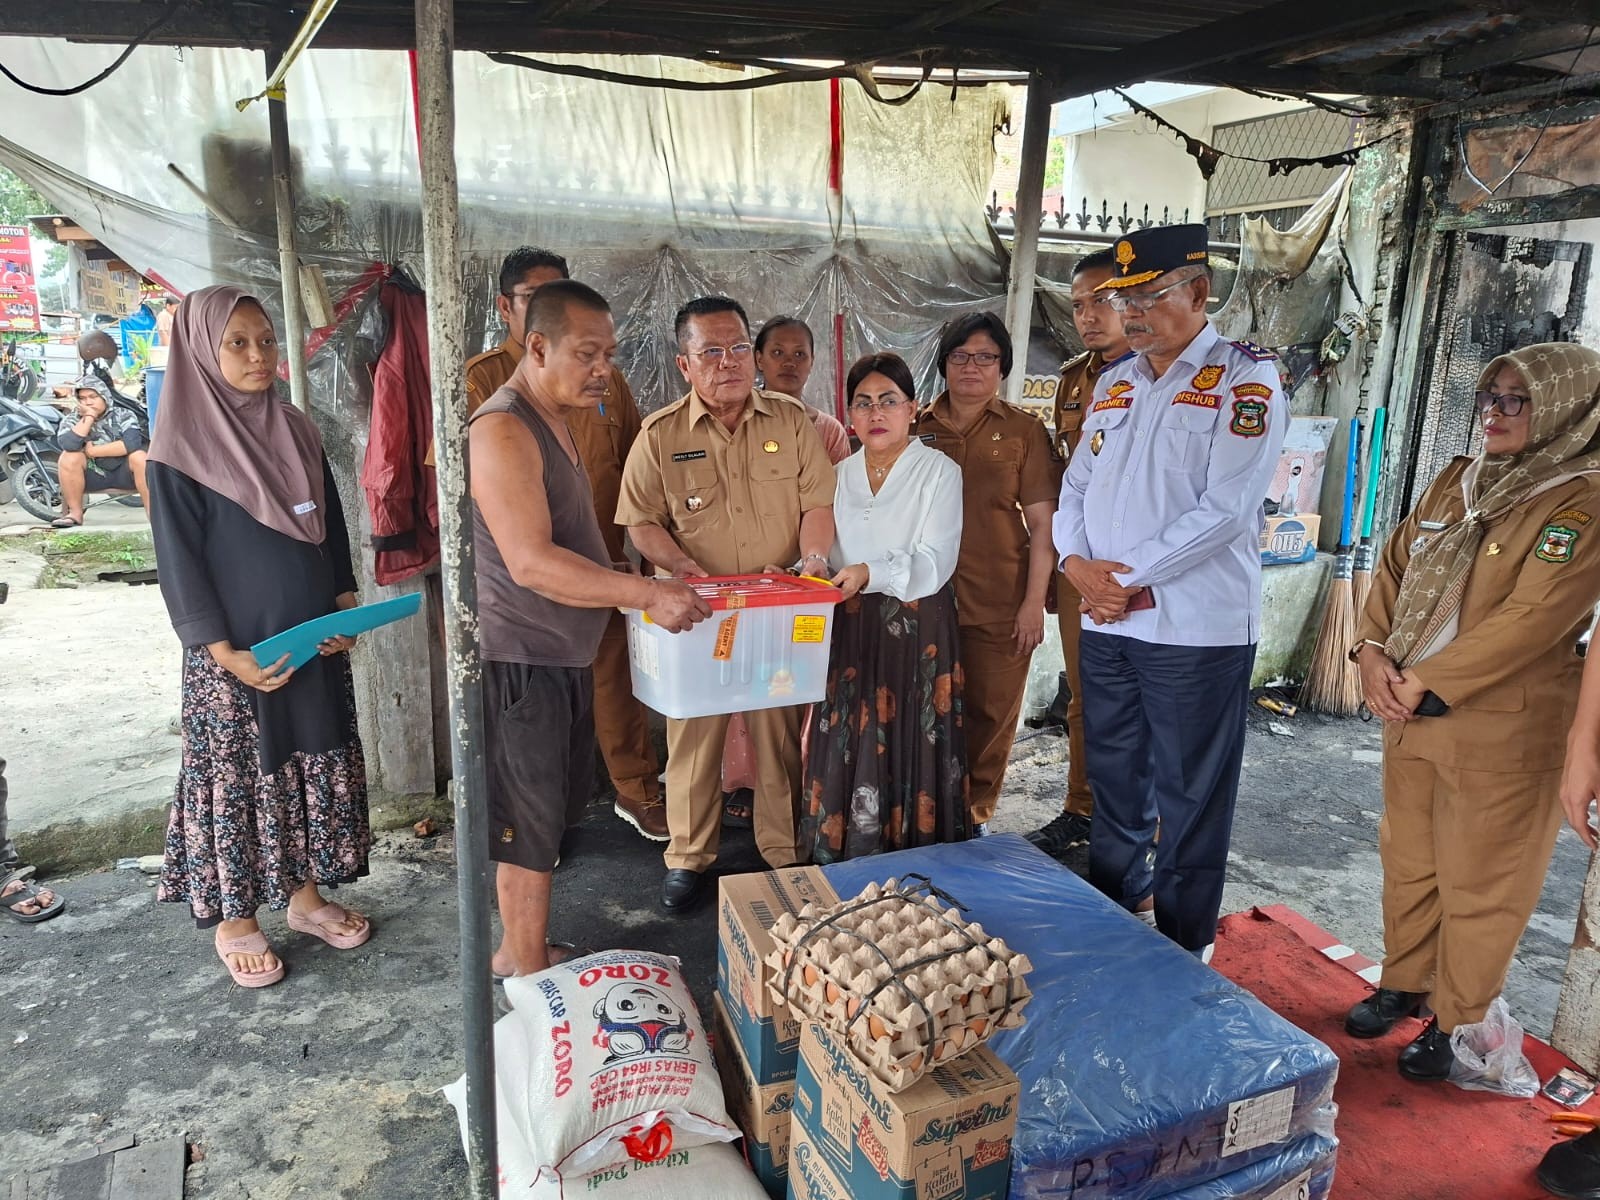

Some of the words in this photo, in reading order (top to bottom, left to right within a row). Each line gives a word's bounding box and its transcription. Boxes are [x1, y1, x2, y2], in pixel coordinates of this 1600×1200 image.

[1096, 398, 1127, 410] DANIEL
[1174, 392, 1216, 406] DISHUB
[579, 964, 673, 988] ZORO
[536, 978, 561, 1000] BERAS
[549, 997, 567, 1018] CAP
[551, 1020, 574, 1098] ZORO
[622, 1061, 652, 1078] IR64
[655, 1060, 697, 1075] BERAS
[590, 1069, 618, 1090] CAP
[826, 1102, 847, 1132] Kaldu
[827, 1119, 849, 1145] Ayam
[857, 1125, 889, 1179] Resep
[973, 1145, 1011, 1166] Resep
[586, 1165, 628, 1191] Padi
[812, 1162, 820, 1172] mi
[818, 1172, 837, 1198] instan
[924, 1170, 958, 1193] Kaldu
[927, 1178, 960, 1200] Ayam
